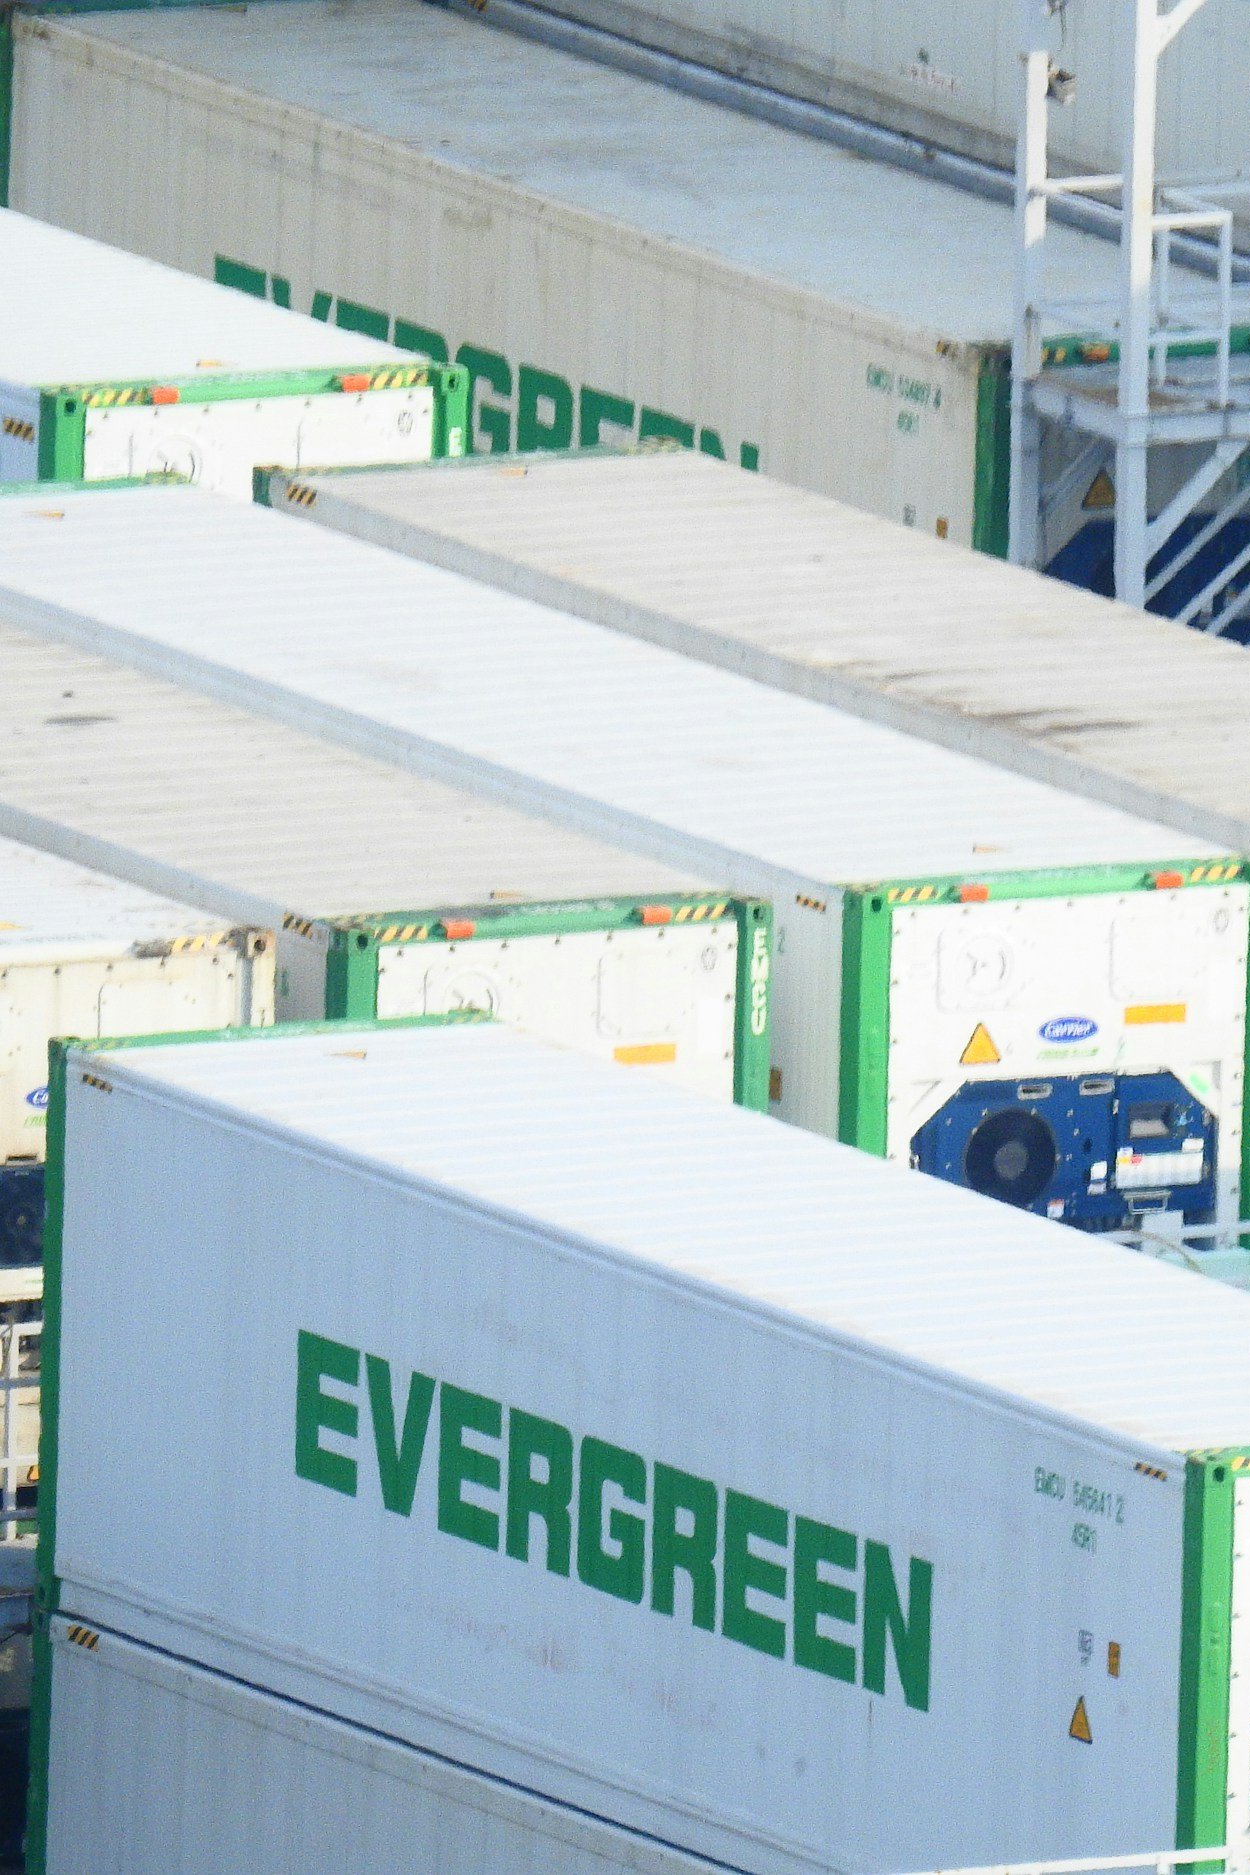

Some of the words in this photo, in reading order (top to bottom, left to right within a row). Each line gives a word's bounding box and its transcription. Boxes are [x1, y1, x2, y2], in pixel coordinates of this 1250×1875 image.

[751, 927, 769, 1036] EMCU
[295, 1329, 933, 1713] EVERGREEN
[1034, 1465, 1066, 1501] EMCU
